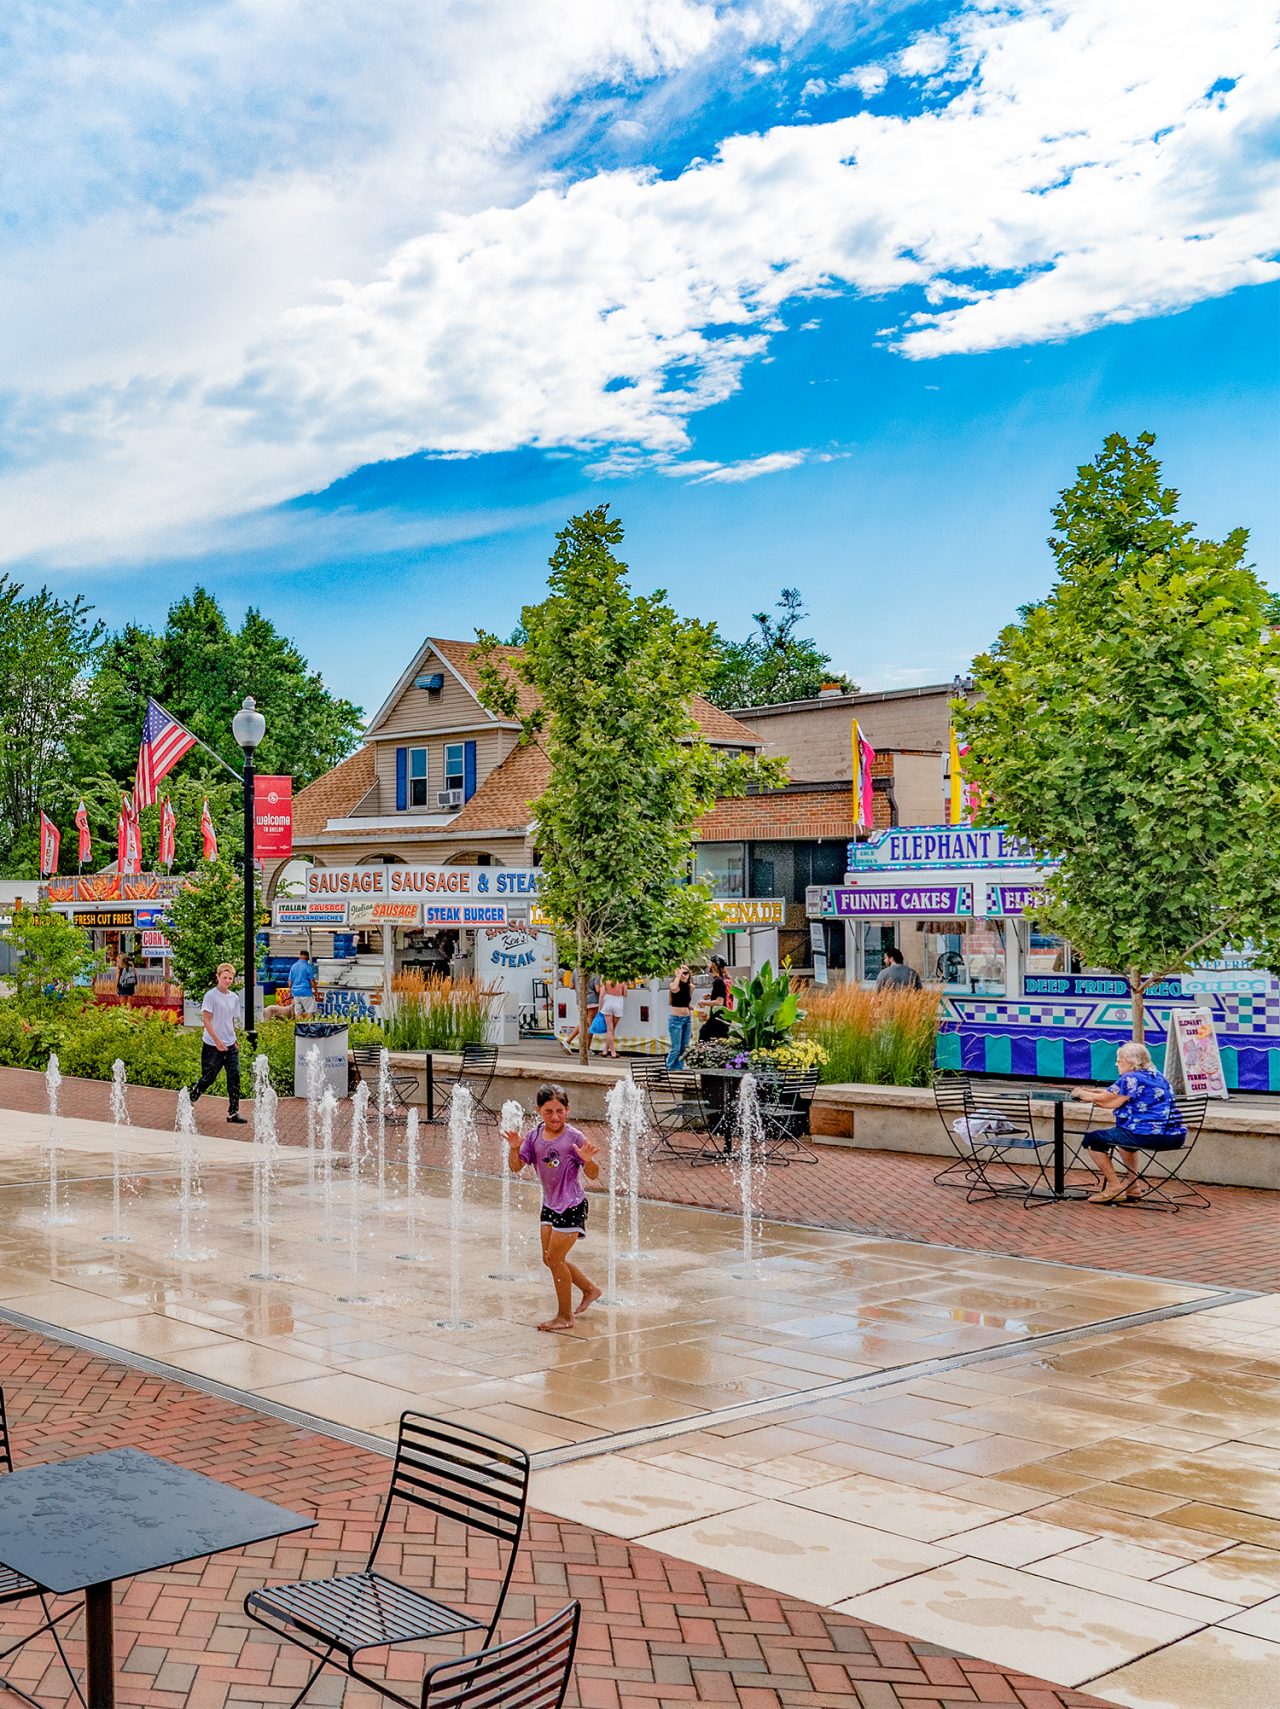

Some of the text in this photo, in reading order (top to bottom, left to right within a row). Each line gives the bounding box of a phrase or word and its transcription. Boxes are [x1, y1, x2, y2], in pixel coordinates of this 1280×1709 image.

[256, 813, 291, 826] welcome
[889, 832, 991, 861] ELEPHANT
[309, 872, 384, 894] SAUSAGE
[391, 872, 470, 893] SAUSAGE
[478, 873, 489, 893] &
[278, 903, 345, 912] ITALIAN SAUSAGE
[840, 893, 898, 911] FUNNEL
[901, 892, 952, 910] CAKES
[350, 903, 373, 916] Italian
[373, 903, 419, 918] SAUSAGE
[427, 906, 505, 922] STEAK BURGER
[74, 914, 96, 925] FRESH
[97, 914, 111, 925] CUT
[112, 913, 133, 925] FRIES
[143, 931, 163, 946] CORN
[502, 932, 528, 948] Ken's
[490, 950, 536, 968] STEAK
[1025, 978, 1070, 994] DEEP
[1074, 979, 1127, 995] FRIED
[1186, 980, 1267, 993] OREOS
[325, 991, 366, 1006] STEAK
[1191, 1083, 1207, 1091] CAKES
